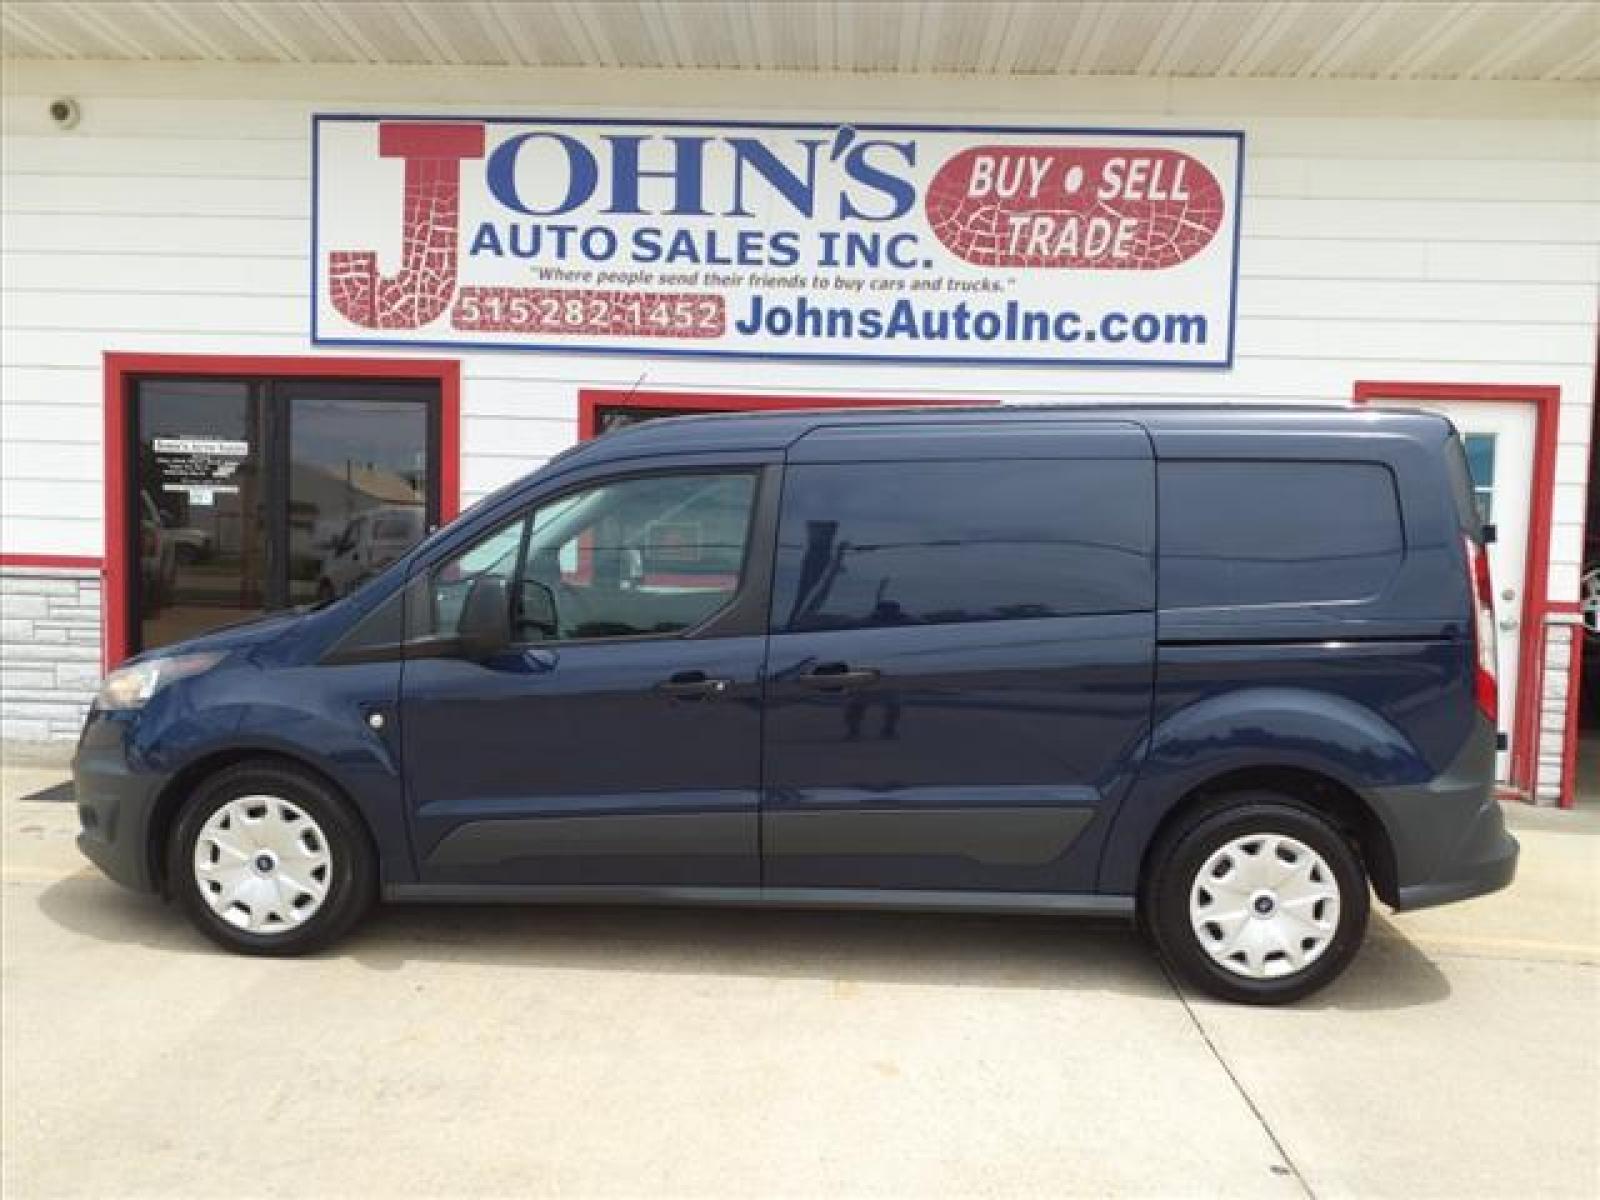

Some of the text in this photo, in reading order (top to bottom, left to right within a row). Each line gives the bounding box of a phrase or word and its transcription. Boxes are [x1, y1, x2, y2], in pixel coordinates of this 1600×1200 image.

[967, 156, 1190, 200] BUY SELL
[329, 122, 918, 328] JOHN'S
[470, 222, 933, 268] AUTO SALES INC.
[1006, 216, 1138, 258] TRADE
[597, 270, 652, 287] people
[658, 272, 699, 285] send
[703, 273, 745, 287] their
[749, 273, 806, 289] friends
[812, 276, 831, 289] to
[834, 275, 866, 292] buy
[869, 279, 905, 291] cars
[909, 277, 943, 291] and
[735, 296, 1208, 344] JohnsAutoInc.com
